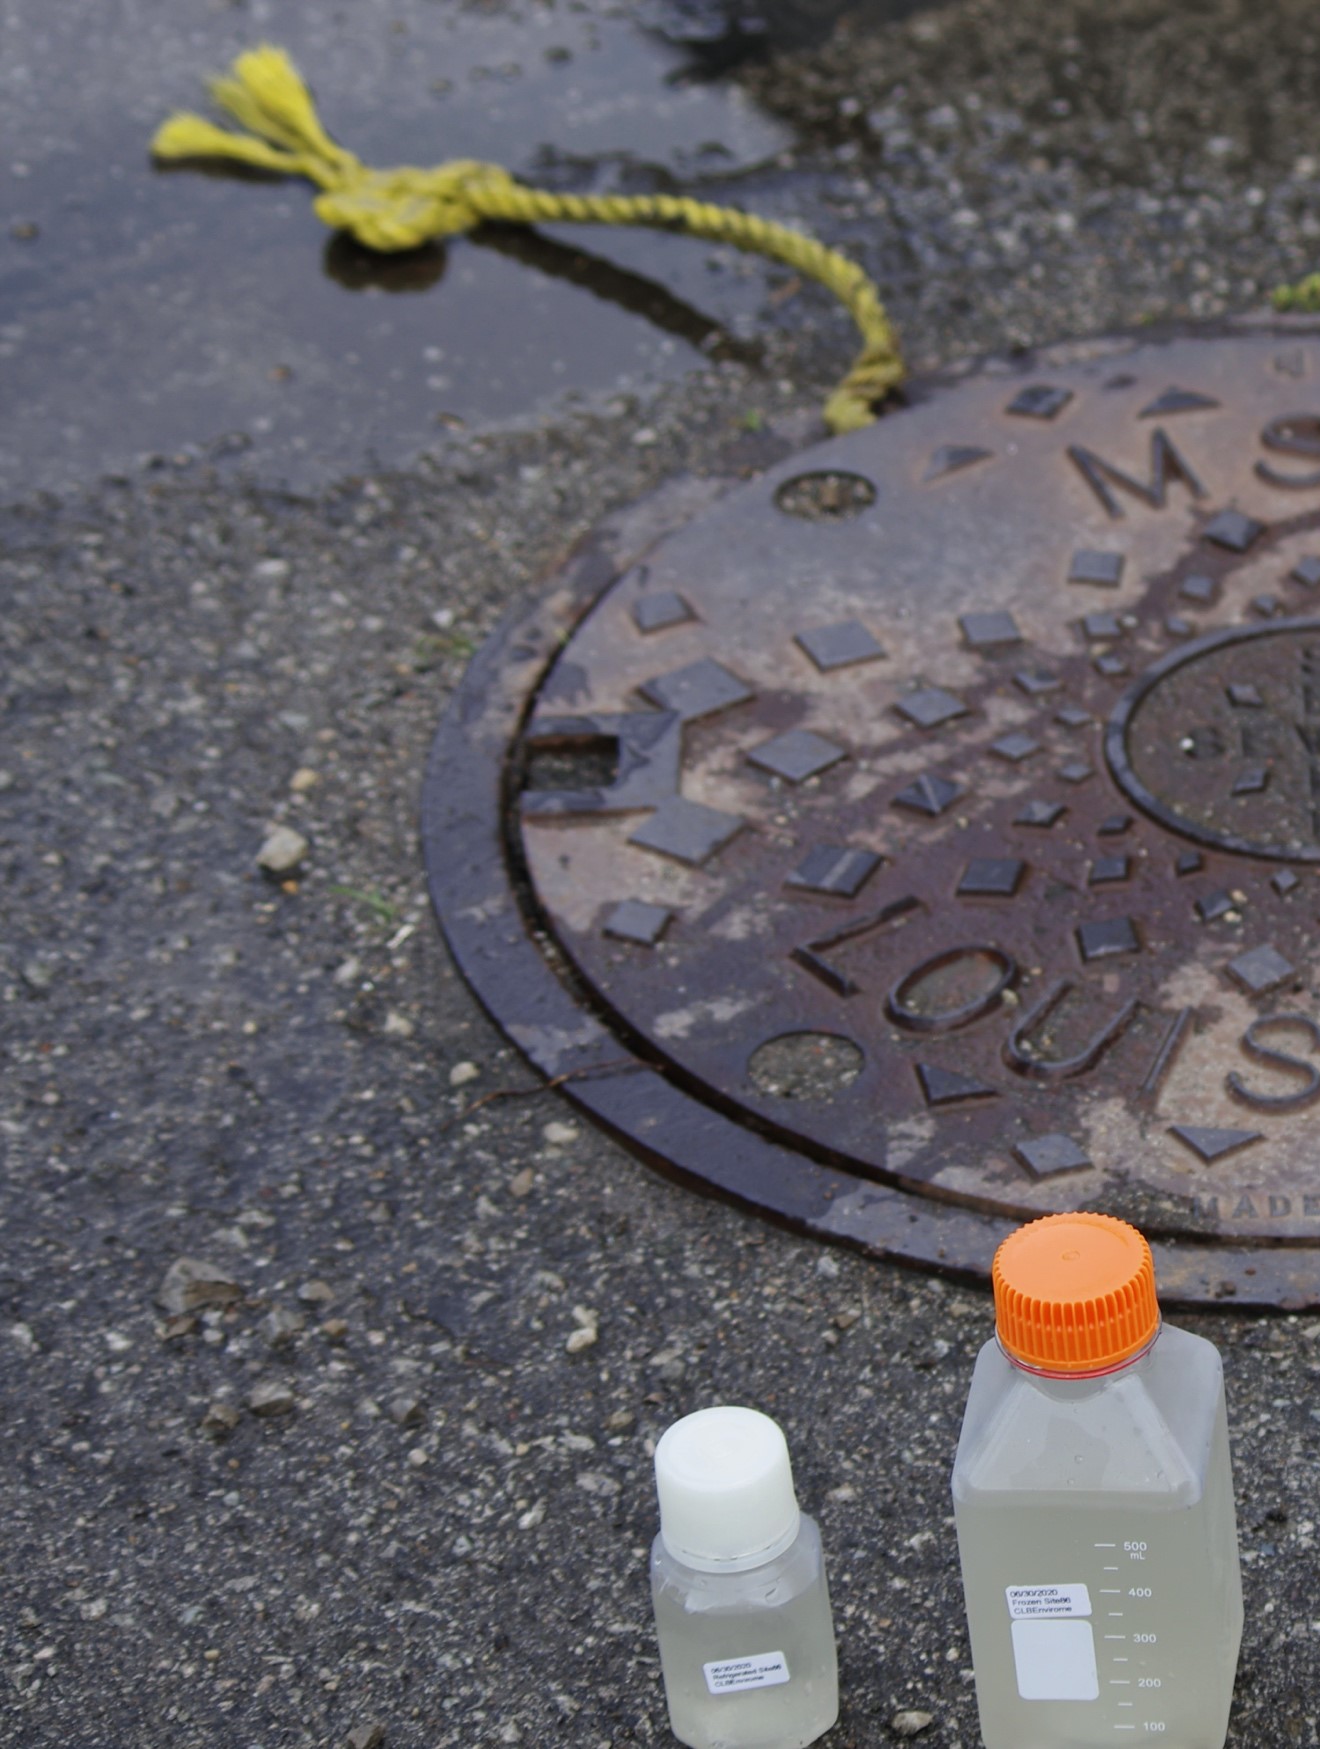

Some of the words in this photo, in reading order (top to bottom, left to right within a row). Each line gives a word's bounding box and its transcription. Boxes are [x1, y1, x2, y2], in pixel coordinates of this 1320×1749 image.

[1123, 1541, 1147, 1551] 500
[1130, 1552, 1146, 1560] mL
[1009, 1589, 1058, 1598] 06/30/2020
[1128, 1588, 1152, 1597] 400
[1013, 1606, 1072, 1615] CLBEnvirome
[1133, 1633, 1157, 1643] 300
[1138, 1678, 1162, 1688] 200
[1143, 1721, 1166, 1731] 100
